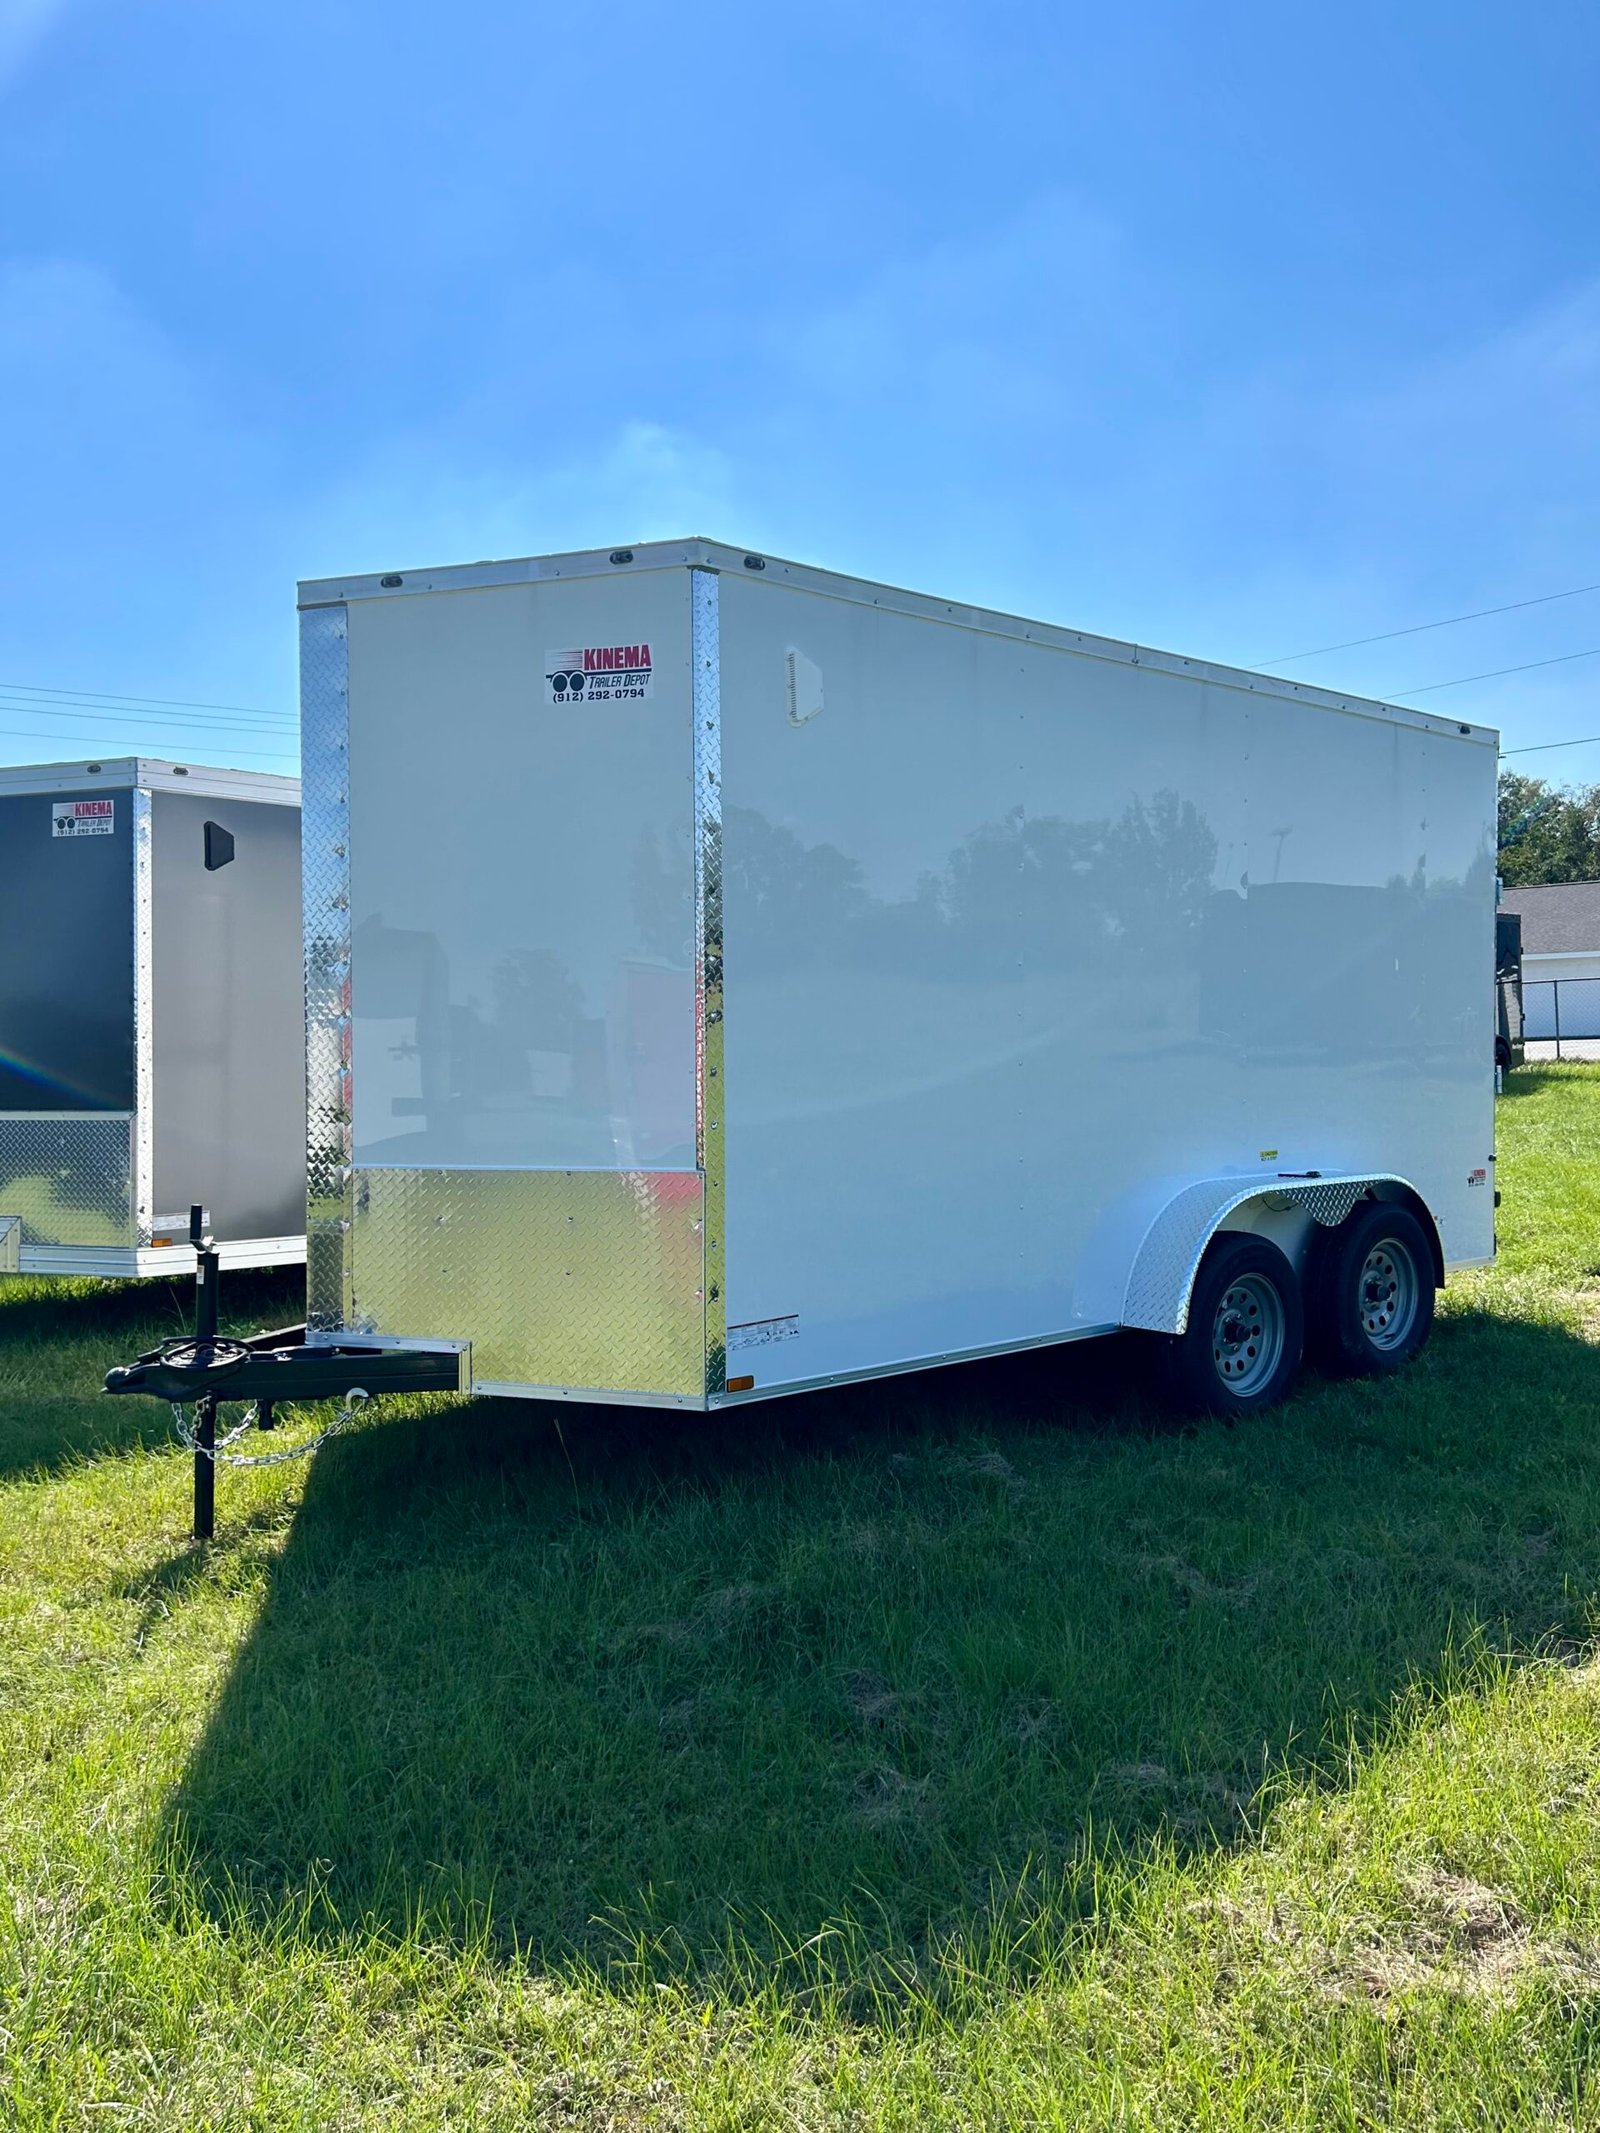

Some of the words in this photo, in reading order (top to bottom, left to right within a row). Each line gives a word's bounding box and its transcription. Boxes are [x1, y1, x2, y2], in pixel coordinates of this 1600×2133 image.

[584, 644, 652, 671] KINEMA
[589, 675, 622, 689] TRAILER
[624, 673, 651, 687] DEPOT
[553, 692, 584, 704] (912)
[587, 688, 645, 700] 292-0794
[75, 801, 112, 816] KINEMA
